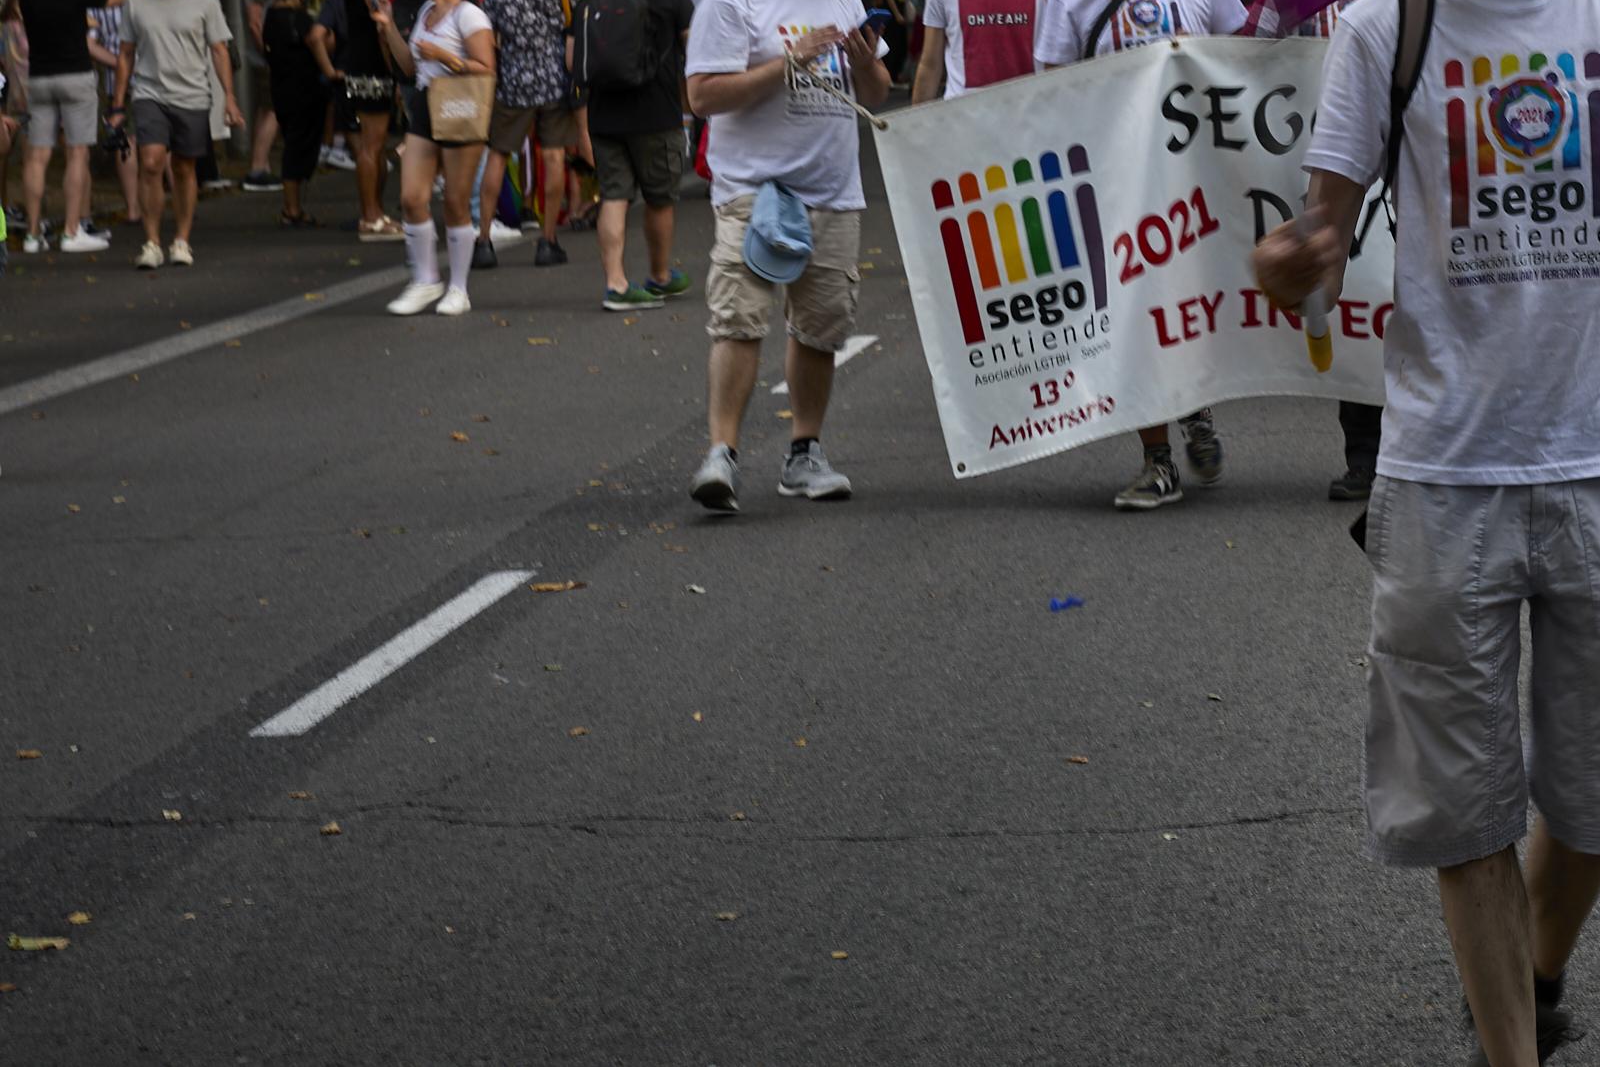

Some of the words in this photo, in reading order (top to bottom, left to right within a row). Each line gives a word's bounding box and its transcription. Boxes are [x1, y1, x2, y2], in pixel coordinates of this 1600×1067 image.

[967, 14, 985, 26] OH
[988, 13, 1028, 25] YEAH!
[1161, 84, 1317, 155] SEG
[1477, 180, 1585, 222] sego
[1114, 186, 1220, 284] 2021
[1553, 251, 1569, 264] de
[986, 279, 1086, 331] sego
[1149, 290, 1224, 349] LEY
[969, 313, 1111, 368] entiende
[974, 360, 1032, 387] Asociación
[1034, 352, 1071, 372] LGTBH
[988, 394, 1116, 450] Aniversario
